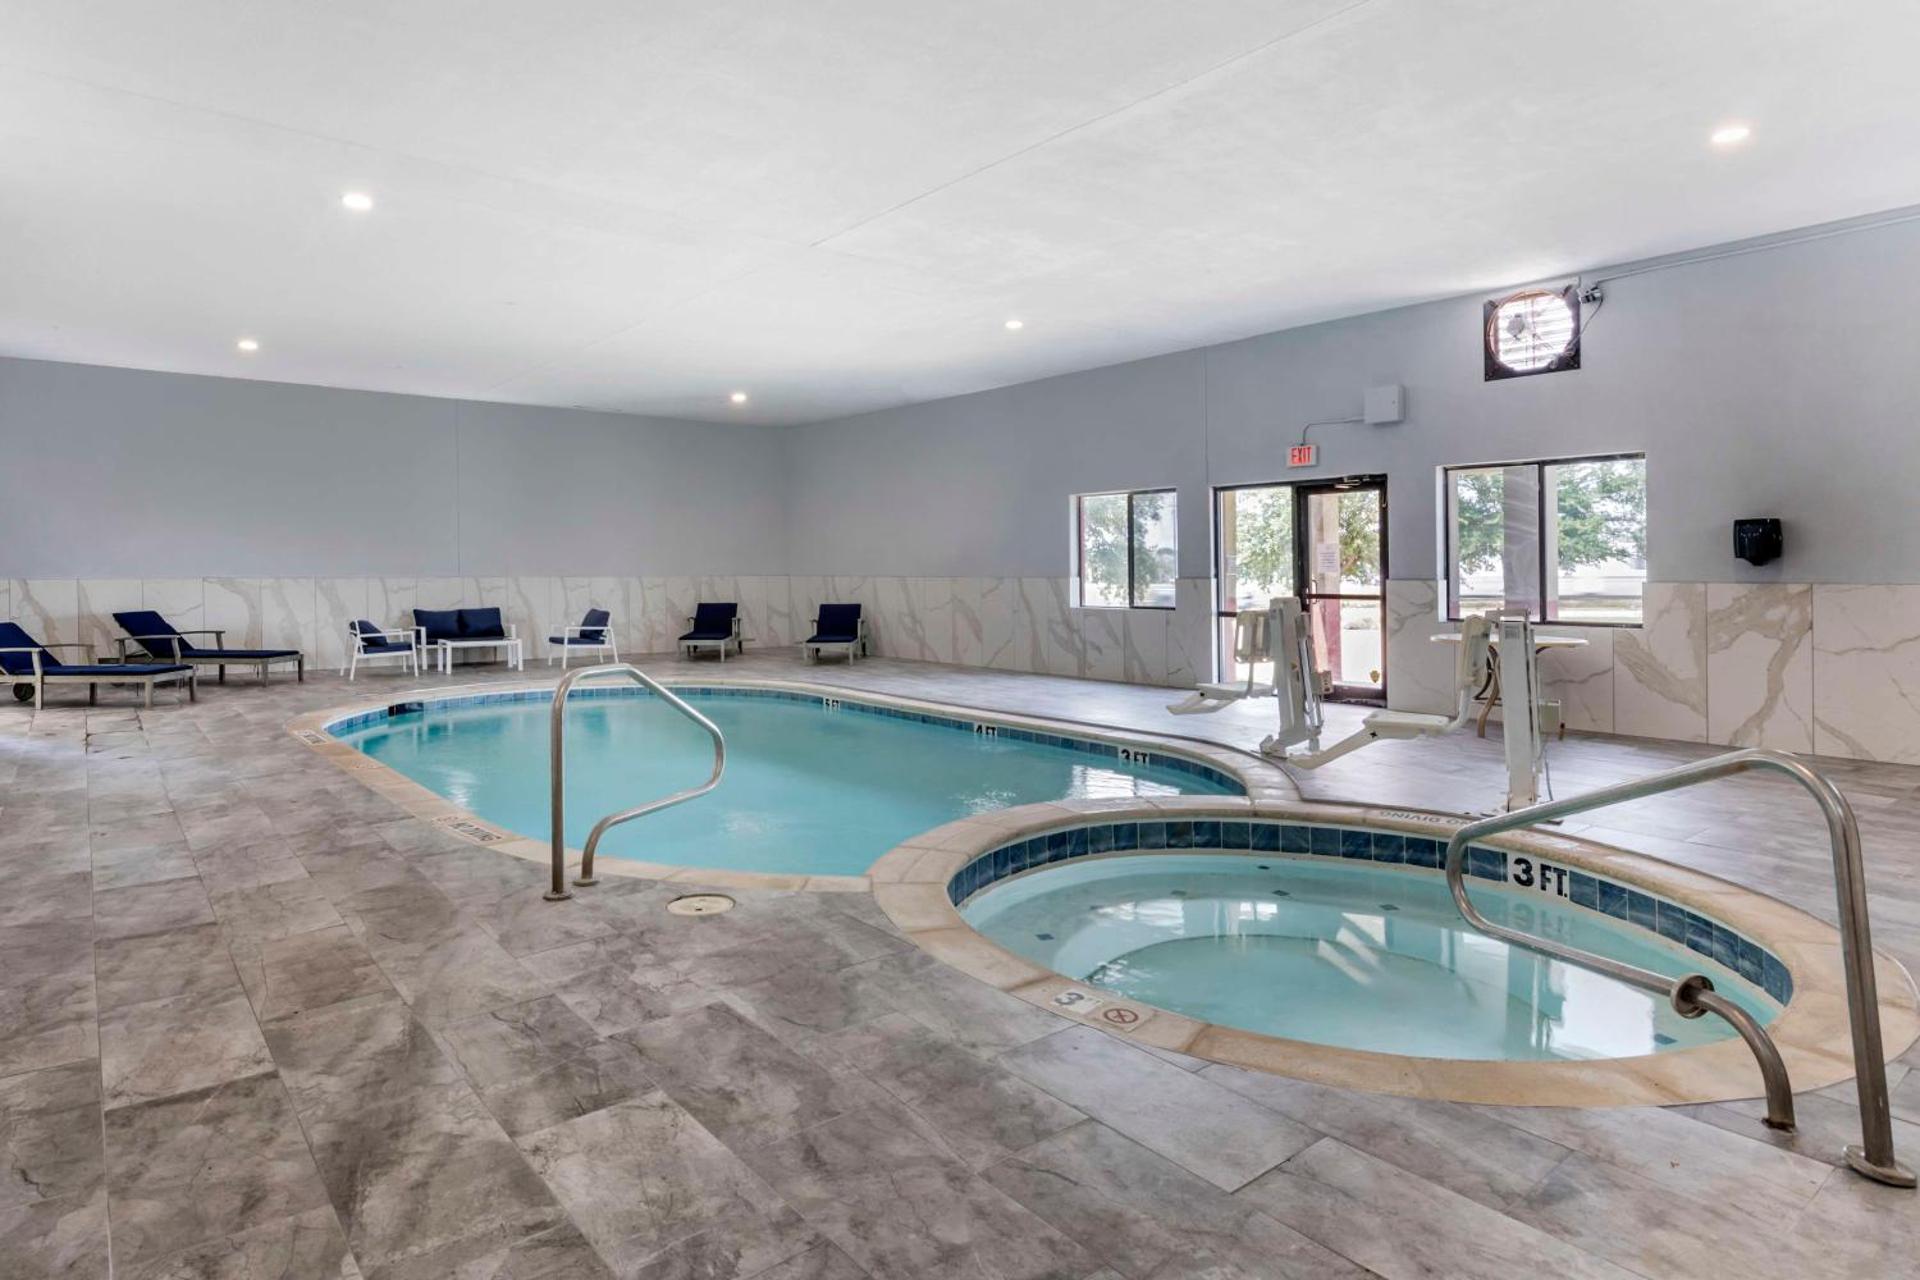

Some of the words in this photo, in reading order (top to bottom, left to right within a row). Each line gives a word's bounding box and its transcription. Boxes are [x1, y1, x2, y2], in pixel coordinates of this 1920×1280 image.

[1291, 446, 1312, 465] EXIT
[986, 726, 997, 736] FT
[1121, 748, 1131, 761] 3
[1133, 750, 1148, 764] FT
[1513, 857, 1535, 887] 3
[1540, 863, 1568, 898] FT.
[1055, 991, 1085, 1006] 3
